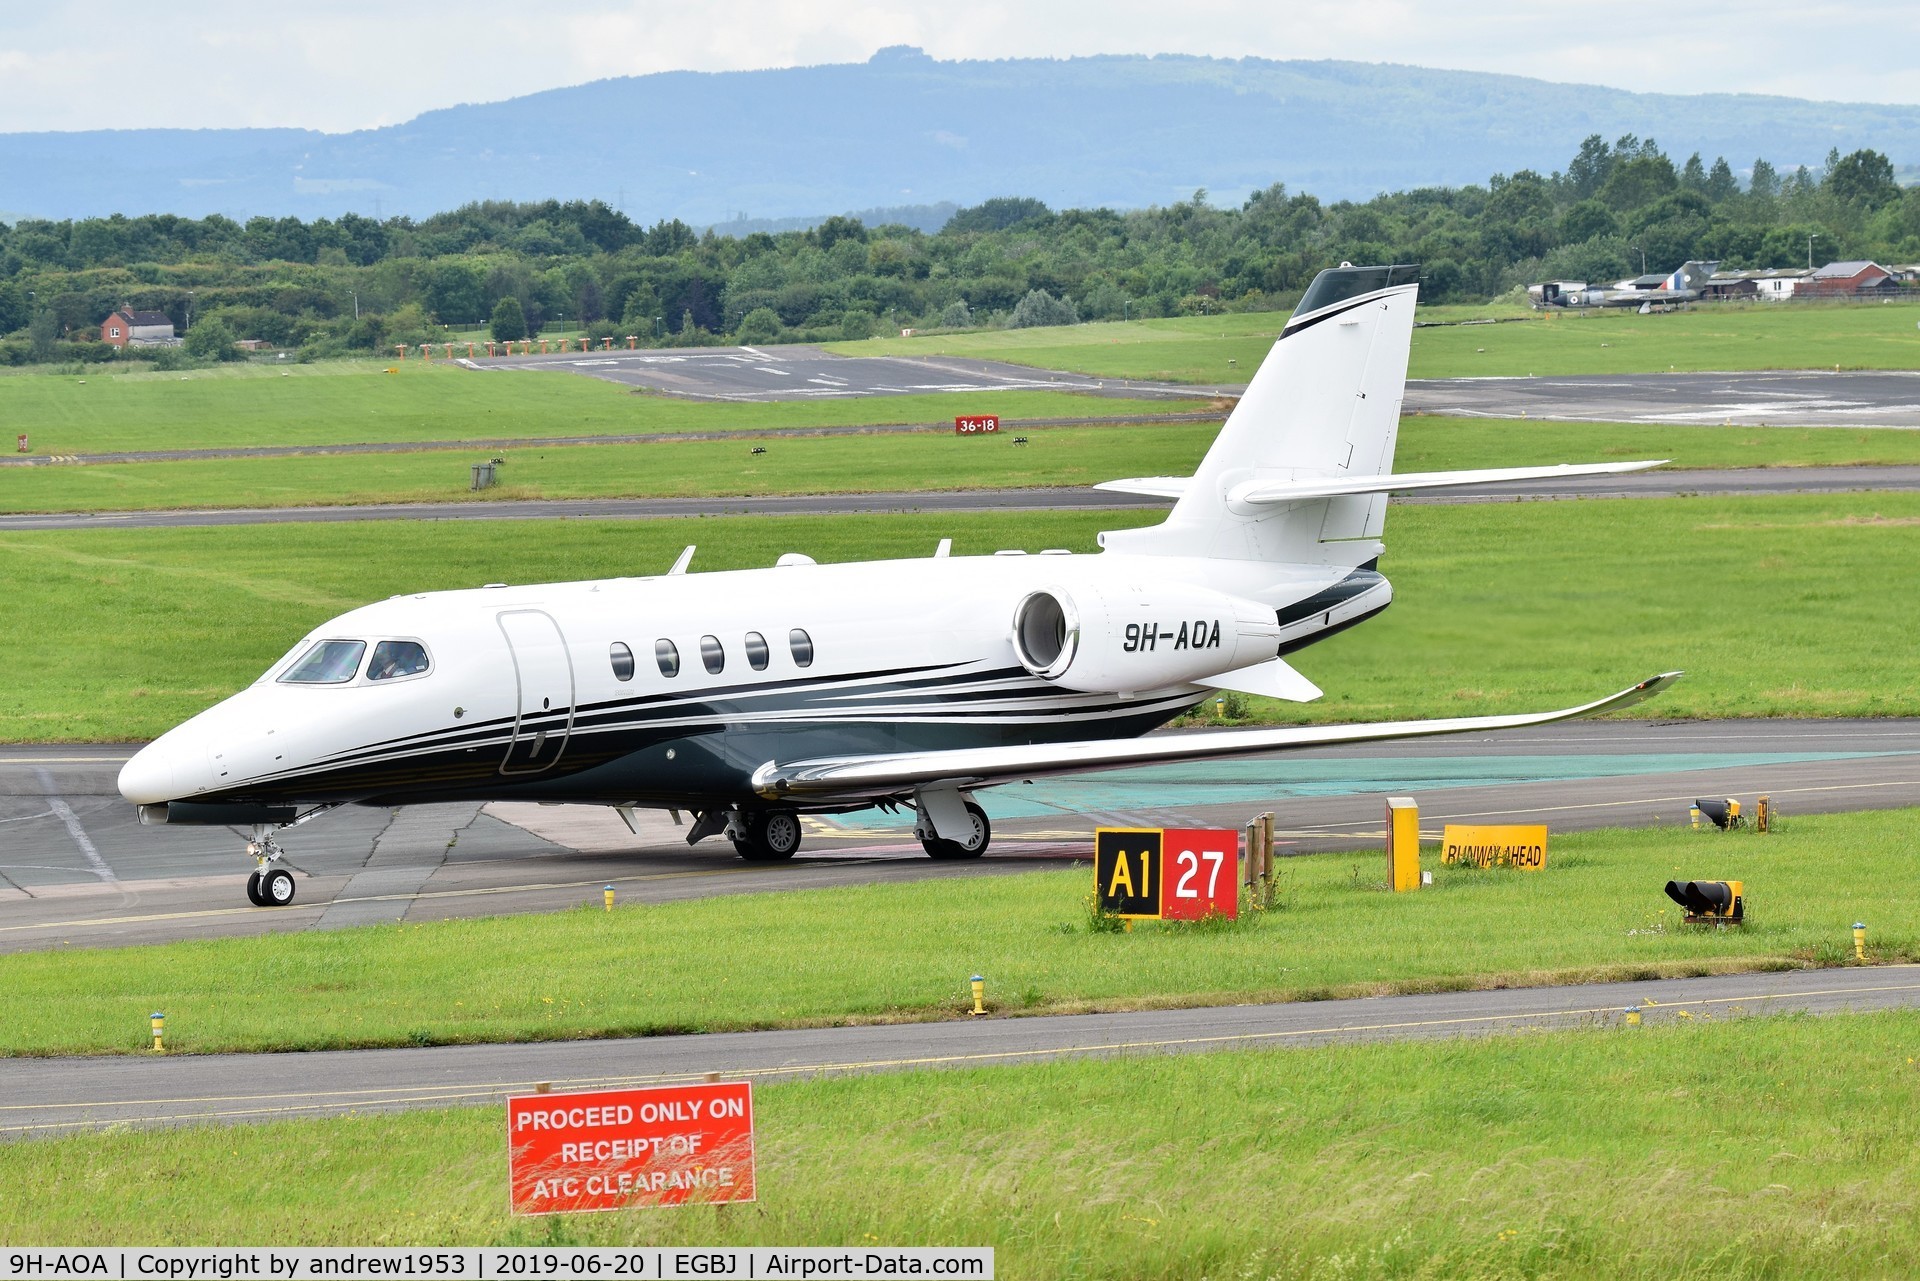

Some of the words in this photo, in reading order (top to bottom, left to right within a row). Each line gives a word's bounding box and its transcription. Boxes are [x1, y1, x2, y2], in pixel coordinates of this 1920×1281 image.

[960, 419, 995, 432] 36-18
[1123, 619, 1221, 652] 9H-AOA
[1108, 850, 1150, 898] A1
[1176, 850, 1224, 899] 27
[517, 1105, 634, 1132] PROCEED
[640, 1101, 703, 1123] ONLY
[709, 1097, 744, 1119] ON
[561, 1137, 664, 1163] RECEIPT
[670, 1134, 703, 1156] OF
[532, 1176, 579, 1200] ATC
[586, 1167, 735, 1196] CLEARANCE
